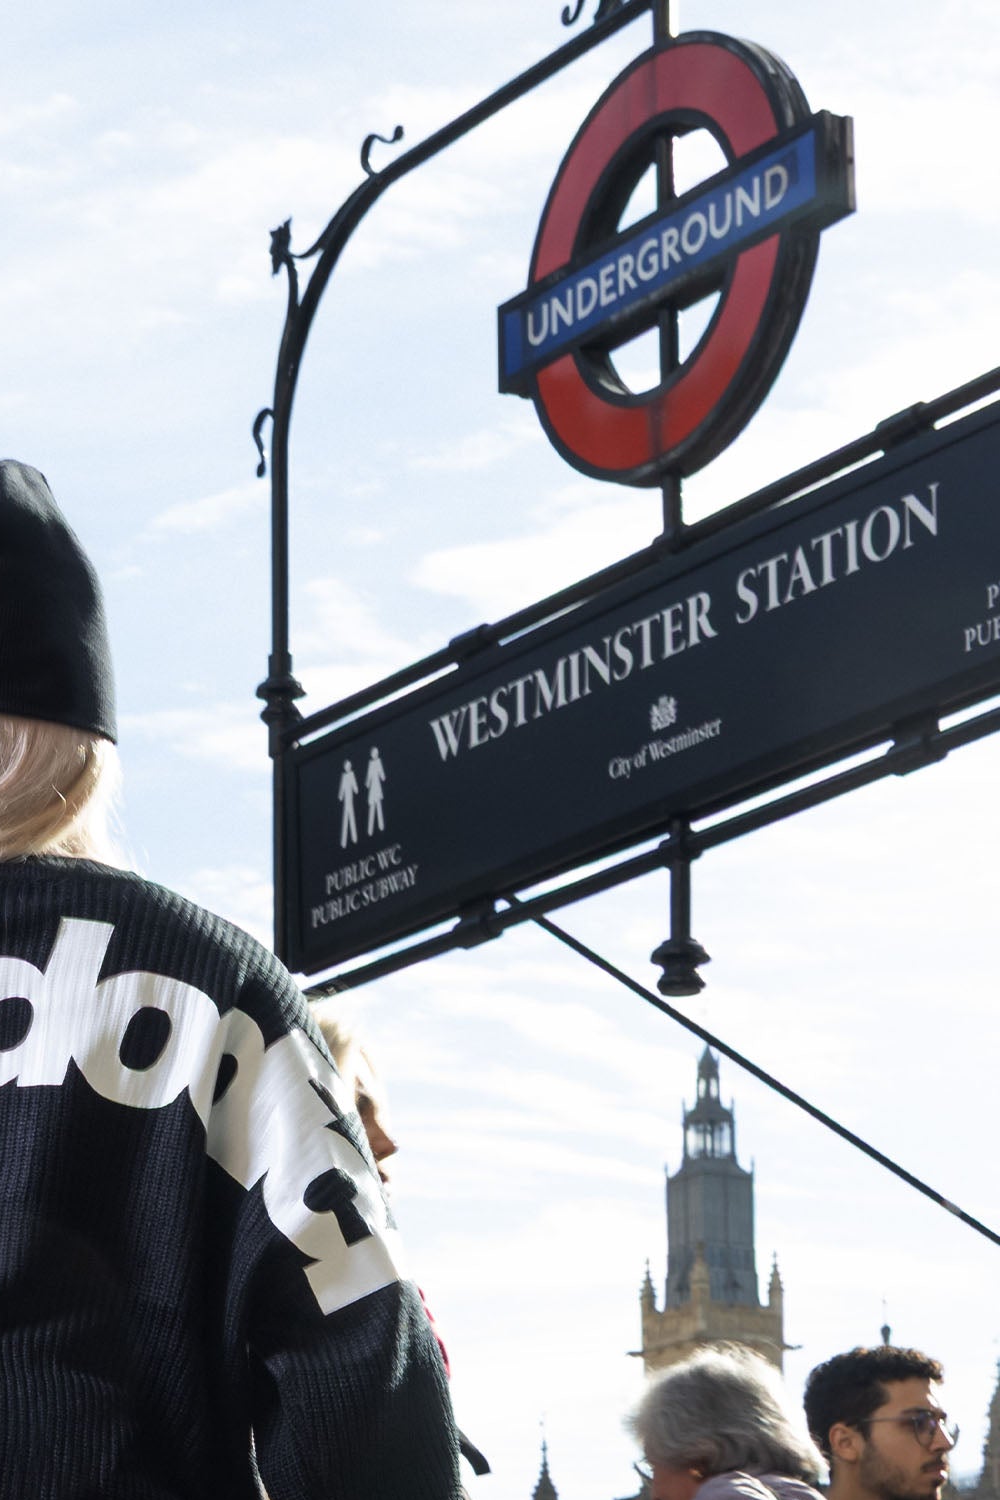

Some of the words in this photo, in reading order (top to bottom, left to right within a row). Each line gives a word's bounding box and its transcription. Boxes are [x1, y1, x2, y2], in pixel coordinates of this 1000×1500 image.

[526, 165, 789, 346] UNDERGROUND
[429, 591, 718, 761] WESTMINSTER
[736, 482, 940, 624] STATION
[608, 757, 632, 779] City
[634, 745, 648, 768] of
[648, 718, 722, 761] Westminster
[311, 889, 361, 928] PUBLIC
[361, 864, 419, 906] SUBWAY
[325, 855, 376, 895] PUBLIC
[376, 843, 402, 870] WC
